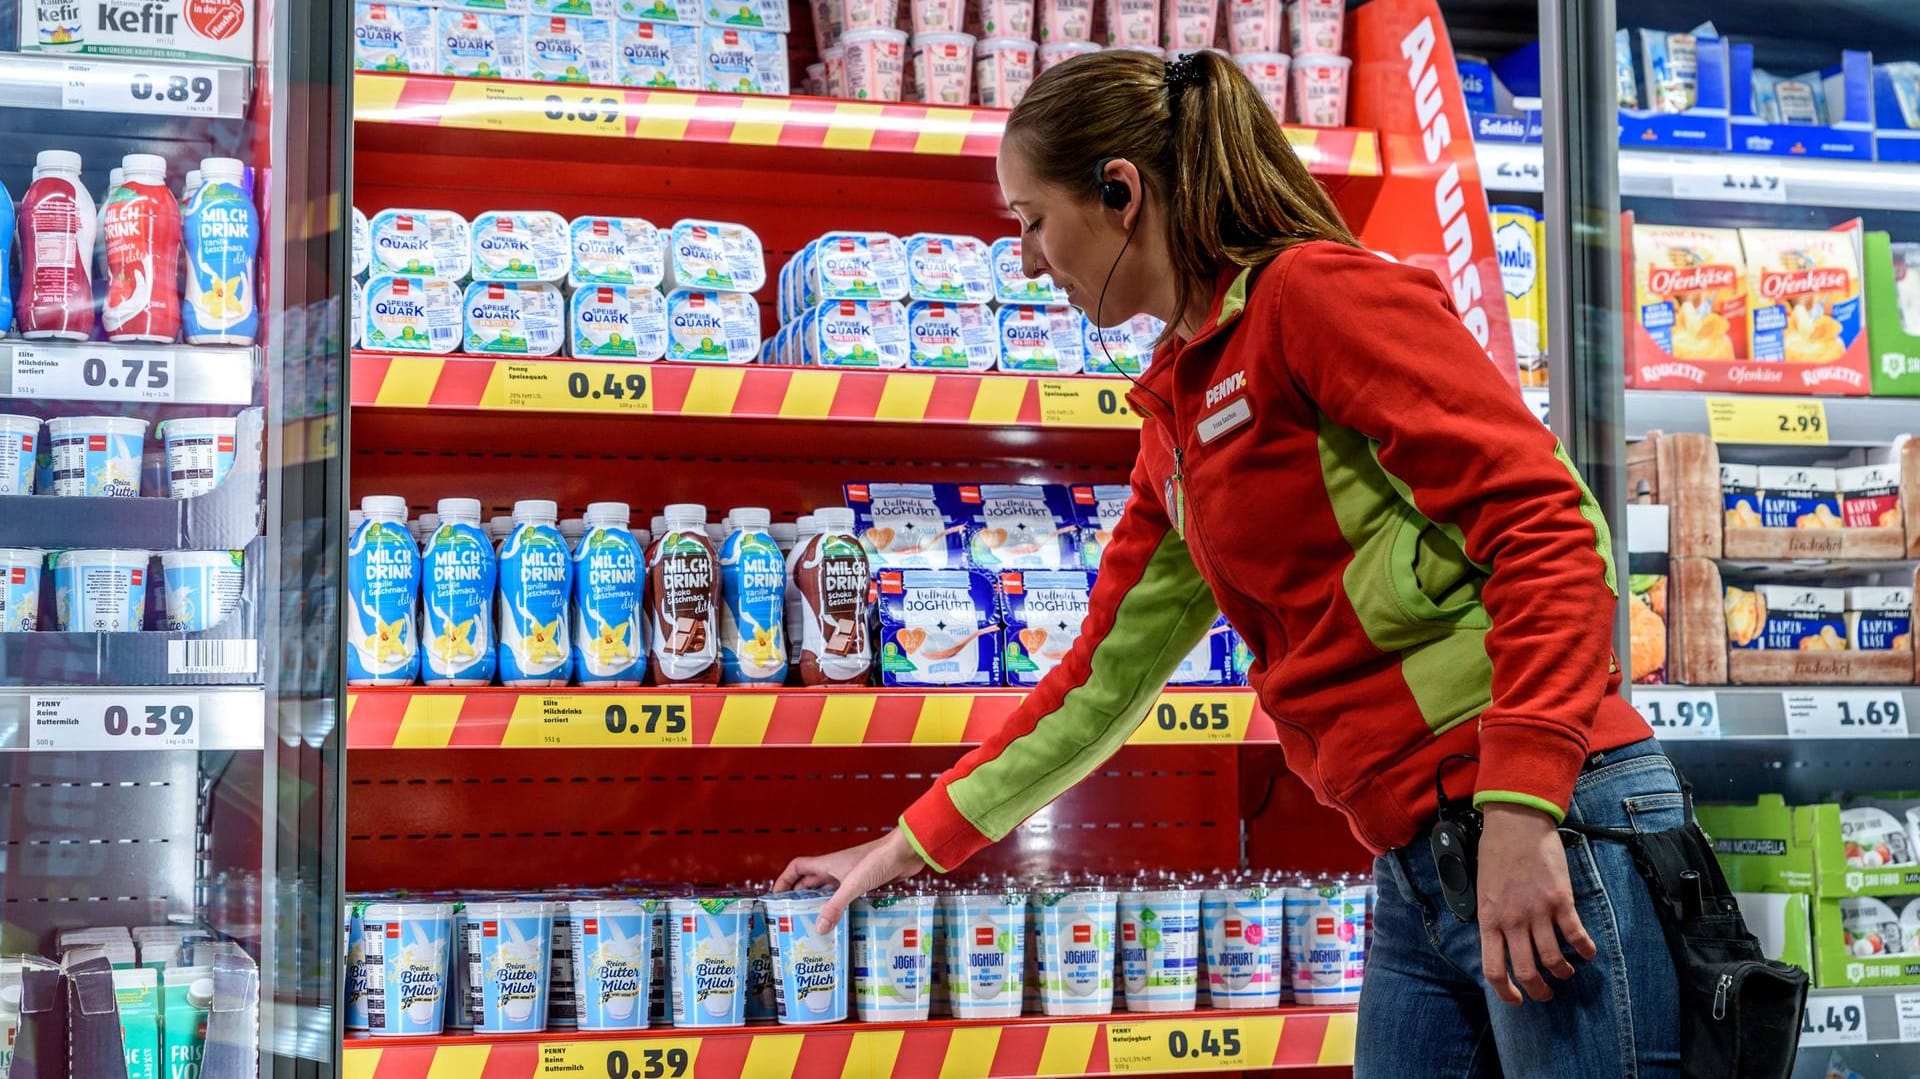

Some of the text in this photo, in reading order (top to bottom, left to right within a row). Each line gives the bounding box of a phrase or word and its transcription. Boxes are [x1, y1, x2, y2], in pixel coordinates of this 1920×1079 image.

[38, 4, 80, 21] Kefir
[98, 3, 178, 34] Kefir
[355, 27, 403, 42] QUARK
[447, 36, 494, 50] QUARK
[535, 40, 582, 55] QUARK
[624, 46, 670, 61] QUARK
[709, 53, 754, 67] QUARK
[130, 73, 213, 103] 0.89
[544, 94, 619, 123] 0.69
[201, 207, 248, 223] MILCH
[201, 222, 249, 239] DRINK
[379, 237, 429, 250] QUARK
[480, 238, 529, 251] QUARK
[578, 242, 625, 256] QUARK
[680, 246, 722, 262] QUARK
[1435, 162, 1495, 361] unse
[1651, 266, 1734, 295] Ofenkäse
[1762, 270, 1846, 298] Ofenkäse
[375, 303, 425, 317] QUARK
[472, 307, 521, 320] QUARK
[582, 311, 628, 324] QUARK
[674, 316, 722, 329] QUARK
[826, 324, 871, 336] QUARK
[915, 325, 960, 337] QUARK
[1007, 328, 1050, 341] QUARK
[1089, 331, 1131, 344] QUARK
[18, 359, 59, 367] Milchdrinks
[83, 358, 169, 389] 0.75
[568, 371, 647, 400] 0.49
[1778, 415, 1821, 432] 2.99
[873, 506, 937, 518] JOGHURT
[986, 507, 1048, 518] JOGHURT
[366, 549, 411, 564] MILCH
[434, 550, 480, 566] MILCH
[521, 551, 565, 567] MILCH
[590, 554, 635, 570] MILCH
[366, 564, 413, 580] DRINK
[664, 558, 708, 574] MILCH
[743, 558, 783, 573] MILCH
[826, 561, 866, 576] MILCH
[433, 565, 482, 582] DRINK
[520, 567, 566, 582] DRINK
[589, 569, 636, 585] DRINK
[663, 573, 709, 589] DRINK
[743, 573, 784, 588] DRINK
[825, 576, 867, 592] DRINK
[666, 589, 691, 598] Schoko
[667, 595, 705, 605] Geschmack
[827, 592, 853, 600] Schoko
[906, 600, 971, 612] JOGHURT
[1028, 600, 1088, 612] JOGHURT
[104, 705, 194, 736] 0.39
[605, 704, 686, 734] 0.75
[1156, 703, 1230, 731] 0.65
[1650, 701, 1714, 727] 1.99
[1837, 701, 1900, 726] 1.69
[605, 960, 627, 968] Reine
[704, 957, 725, 966] Reine
[802, 956, 823, 964] Reine
[968, 952, 1004, 967] JOGHURT
[1063, 949, 1099, 965] JOGHURT
[1218, 951, 1254, 966] JOGHURT
[1308, 949, 1346, 964] JOGHURT
[409, 964, 430, 973] Reine
[505, 962, 526, 971] Reine
[598, 965, 640, 980] Butter
[696, 963, 736, 977] Butter
[795, 961, 835, 975] Butter
[400, 970, 440, 984] Butter
[496, 968, 538, 982] Butter
[797, 975, 835, 988] Milch
[401, 984, 439, 998] Milch
[498, 982, 536, 996] Milch
[600, 979, 638, 993] Milch
[697, 977, 734, 990] Milch
[1802, 1005, 1861, 1033] 1.49
[1113, 1035, 1152, 1044] Naturjoghurt
[1168, 1028, 1241, 1059] 0.45
[545, 1063, 584, 1072] Buttermilch
[606, 1048, 689, 1079] 0.39
